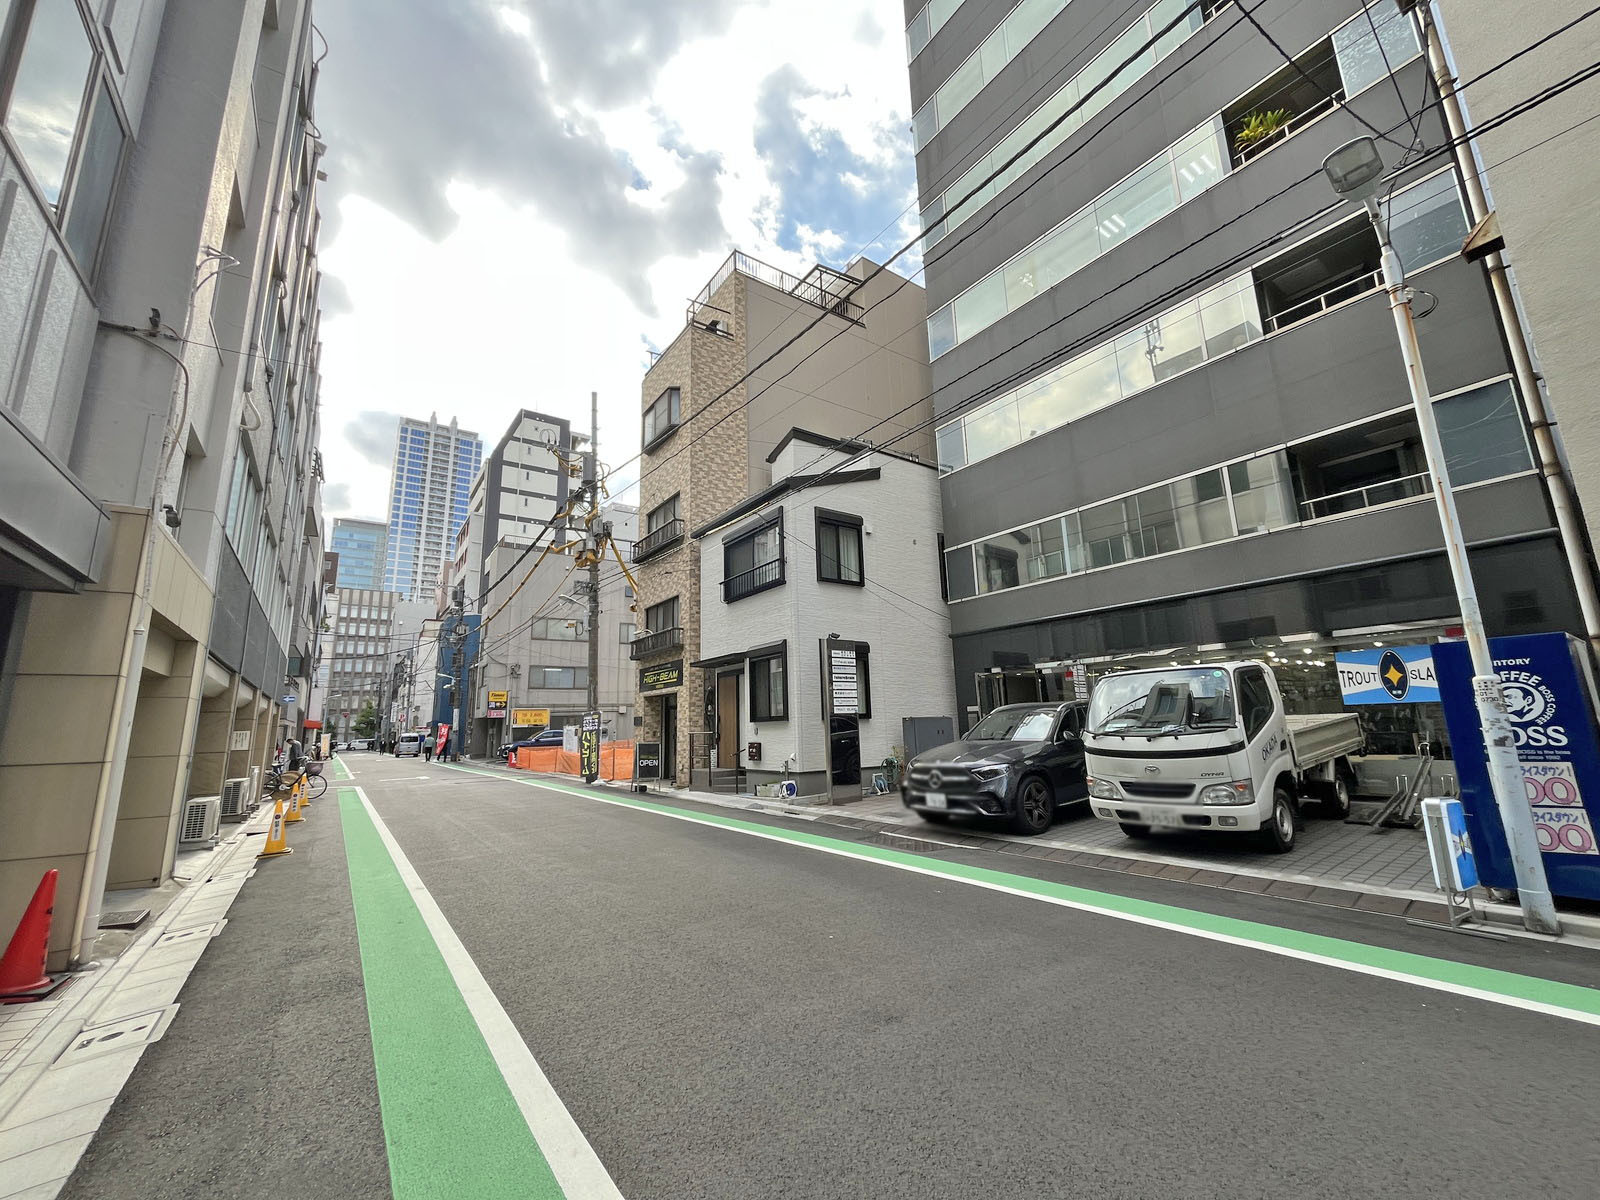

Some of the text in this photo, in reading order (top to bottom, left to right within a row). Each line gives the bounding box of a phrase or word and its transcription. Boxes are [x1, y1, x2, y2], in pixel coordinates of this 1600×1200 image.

[1493, 658, 1531, 667] NTORY
[643, 670, 679, 684] HIGH-BEAM
[1339, 667, 1436, 688] TROUT SLA
[1500, 671, 1542, 686] FFEE
[1535, 685, 1557, 725] BOSS COFFEE
[1261, 734, 1278, 761] OKADA
[640, 759, 659, 767] OPEN
